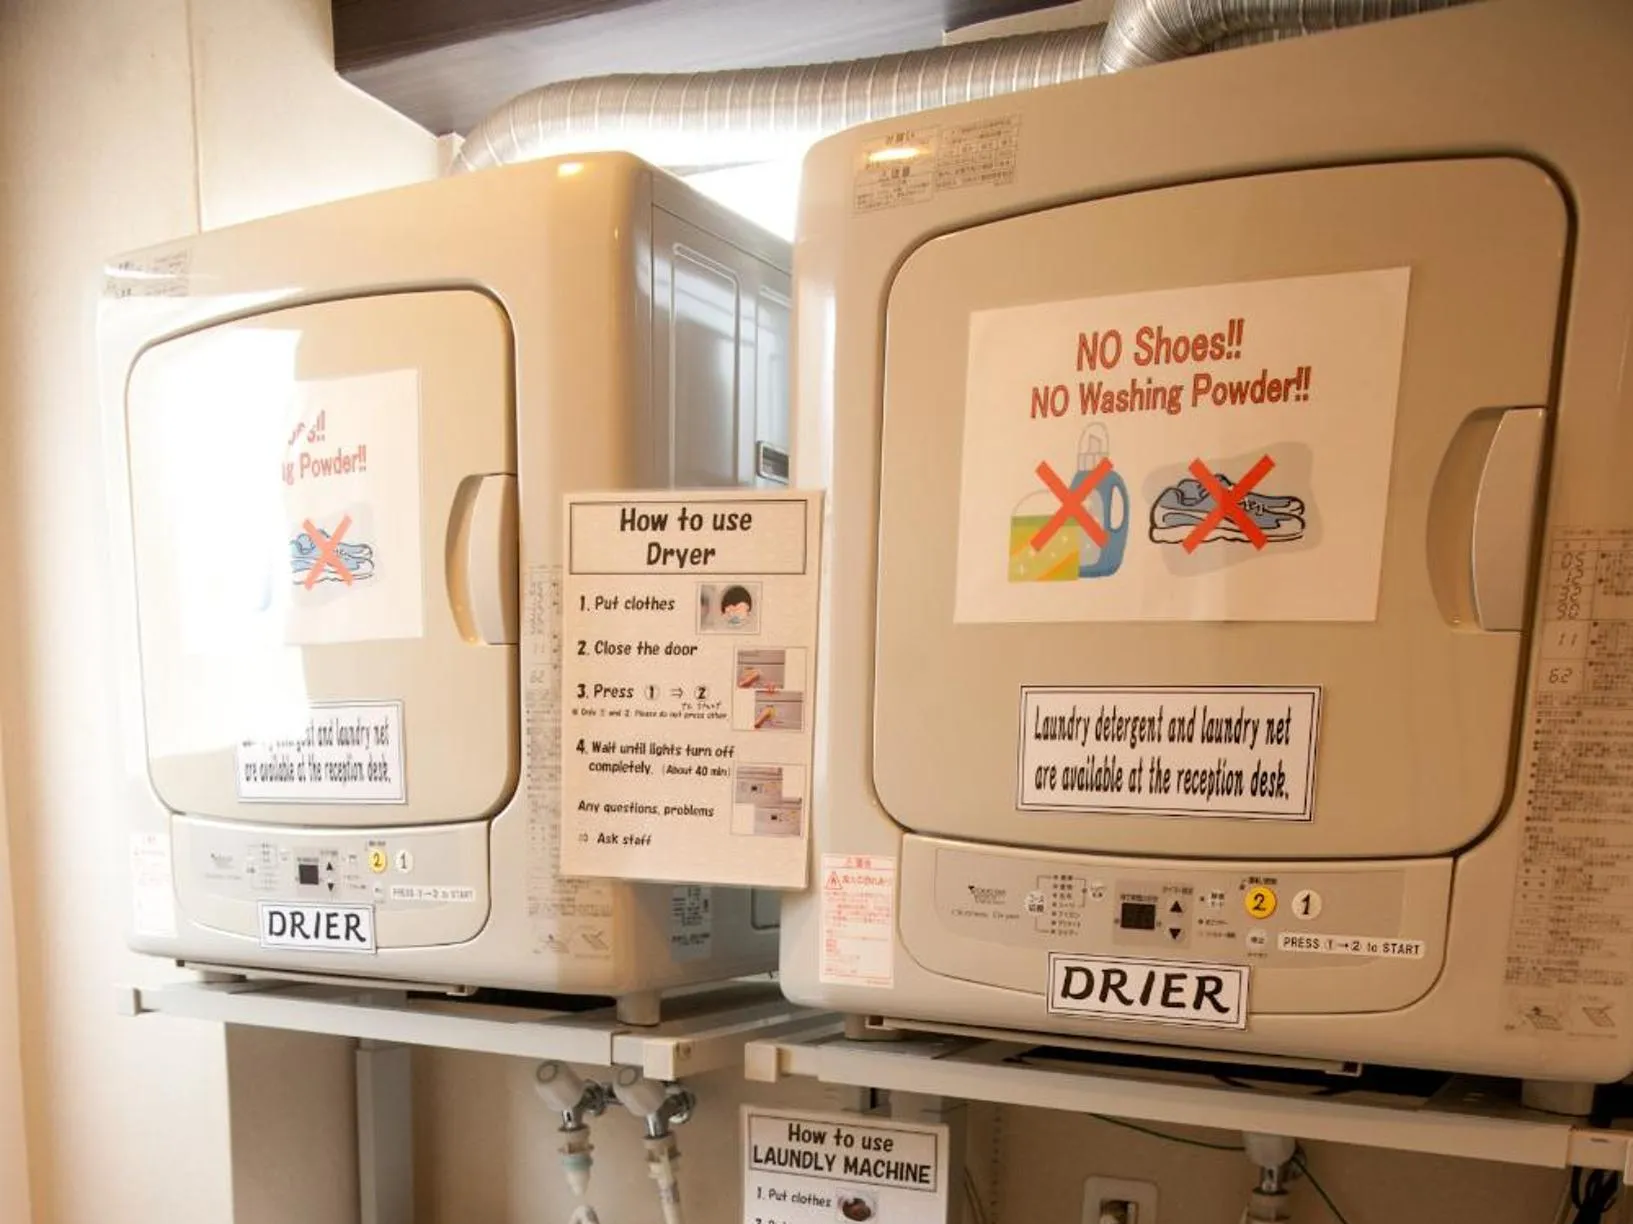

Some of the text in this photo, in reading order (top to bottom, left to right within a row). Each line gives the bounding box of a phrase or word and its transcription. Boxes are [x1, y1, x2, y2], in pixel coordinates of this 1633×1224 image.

[1076, 318, 1245, 371] NO Shoes!!
[1029, 366, 1313, 418] NO Washing Powder!!
[300, 444, 367, 479] Powder!!
[619, 508, 752, 532] How to use
[646, 541, 716, 569] Dryer
[580, 595, 675, 611] 1. Put clothes
[577, 640, 698, 656] 2. Close the door
[576, 683, 589, 699] 3.
[593, 683, 634, 699] Press
[318, 718, 334, 746] and
[336, 717, 370, 751] laundry
[374, 715, 390, 746] net
[1034, 704, 1292, 750] Laundry detergent and laundry net
[576, 738, 735, 758] 4. Wait until lights turn off
[245, 762, 257, 782] are
[260, 752, 295, 782] available
[308, 752, 322, 782] the
[324, 752, 365, 787] reception
[695, 765, 708, 777] 40
[1035, 754, 1290, 800] are available at the reception desk.
[578, 800, 599, 813] Any
[664, 804, 715, 817] problems
[597, 832, 652, 846] Ask staff
[373, 852, 382, 867] 2
[1252, 892, 1266, 912] 2
[1301, 892, 1311, 915] 1
[268, 910, 367, 943] DRIER
[1283, 936, 1321, 949] PRESS
[1367, 942, 1377, 953] to
[1382, 943, 1421, 955] START
[1060, 965, 1231, 1015] DRIER
[788, 1123, 894, 1152] How to use
[753, 1145, 931, 1185] LAUNDLY MACHINE
[768, 1188, 787, 1201] Put
[791, 1192, 832, 1208] clothes
